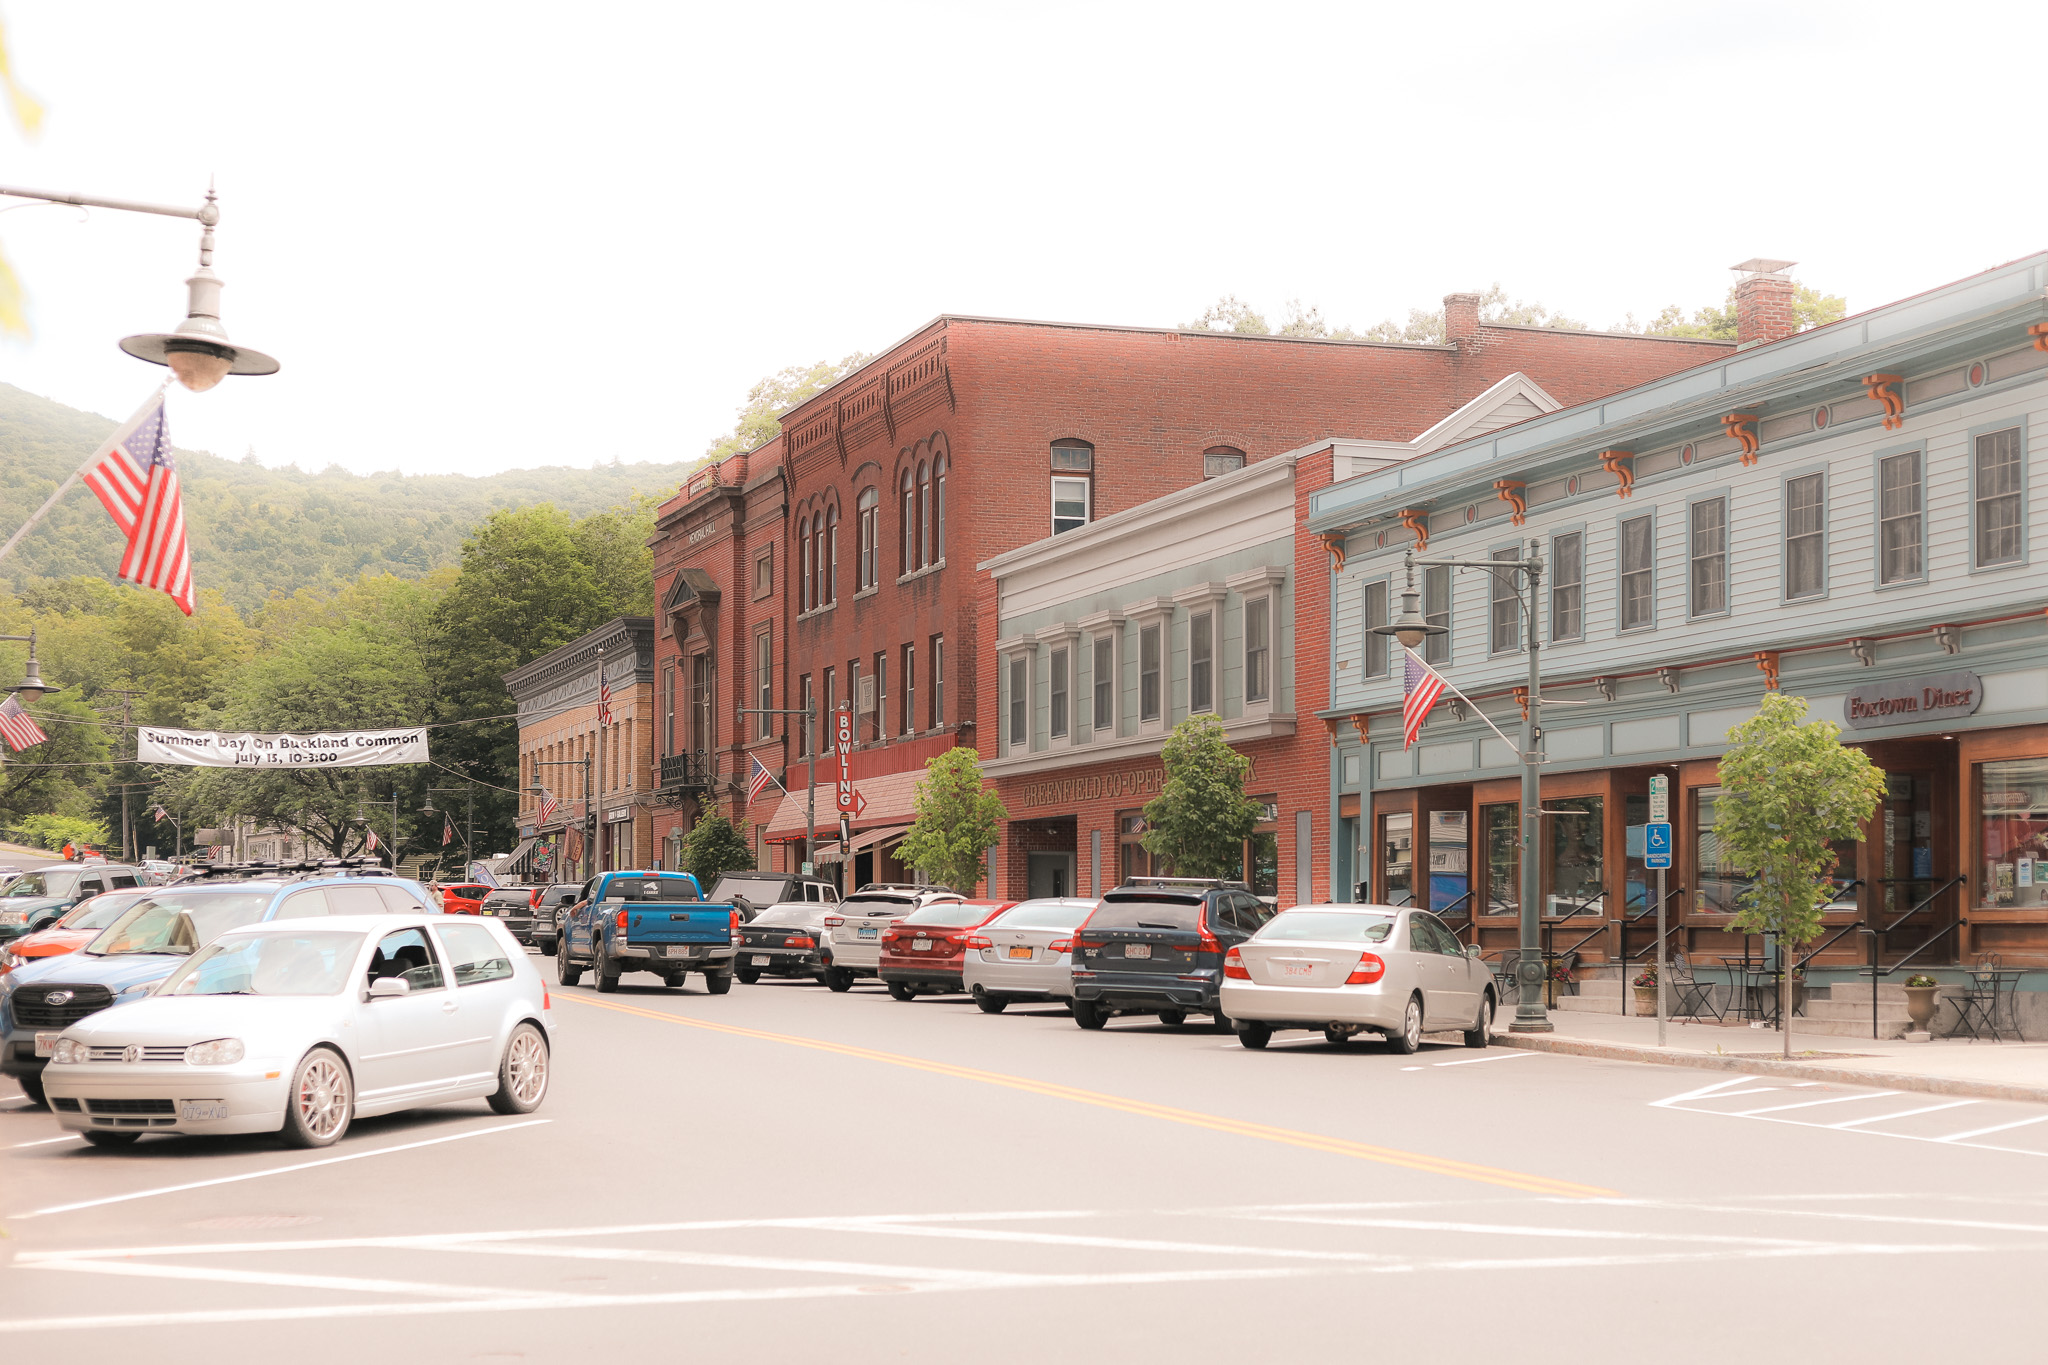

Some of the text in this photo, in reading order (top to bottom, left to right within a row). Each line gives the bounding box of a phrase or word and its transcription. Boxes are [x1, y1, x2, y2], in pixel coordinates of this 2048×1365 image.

[1850, 686, 1973, 719] Foxtown Diner
[148, 732, 419, 751] Summer Day On Buckland Common
[234, 752, 338, 765] July 15, 10-3:00
[838, 715, 851, 806] BOWLING
[1023, 767, 1165, 807] GREENFIELD CO-OPER
[1285, 967, 1297, 976] 384
